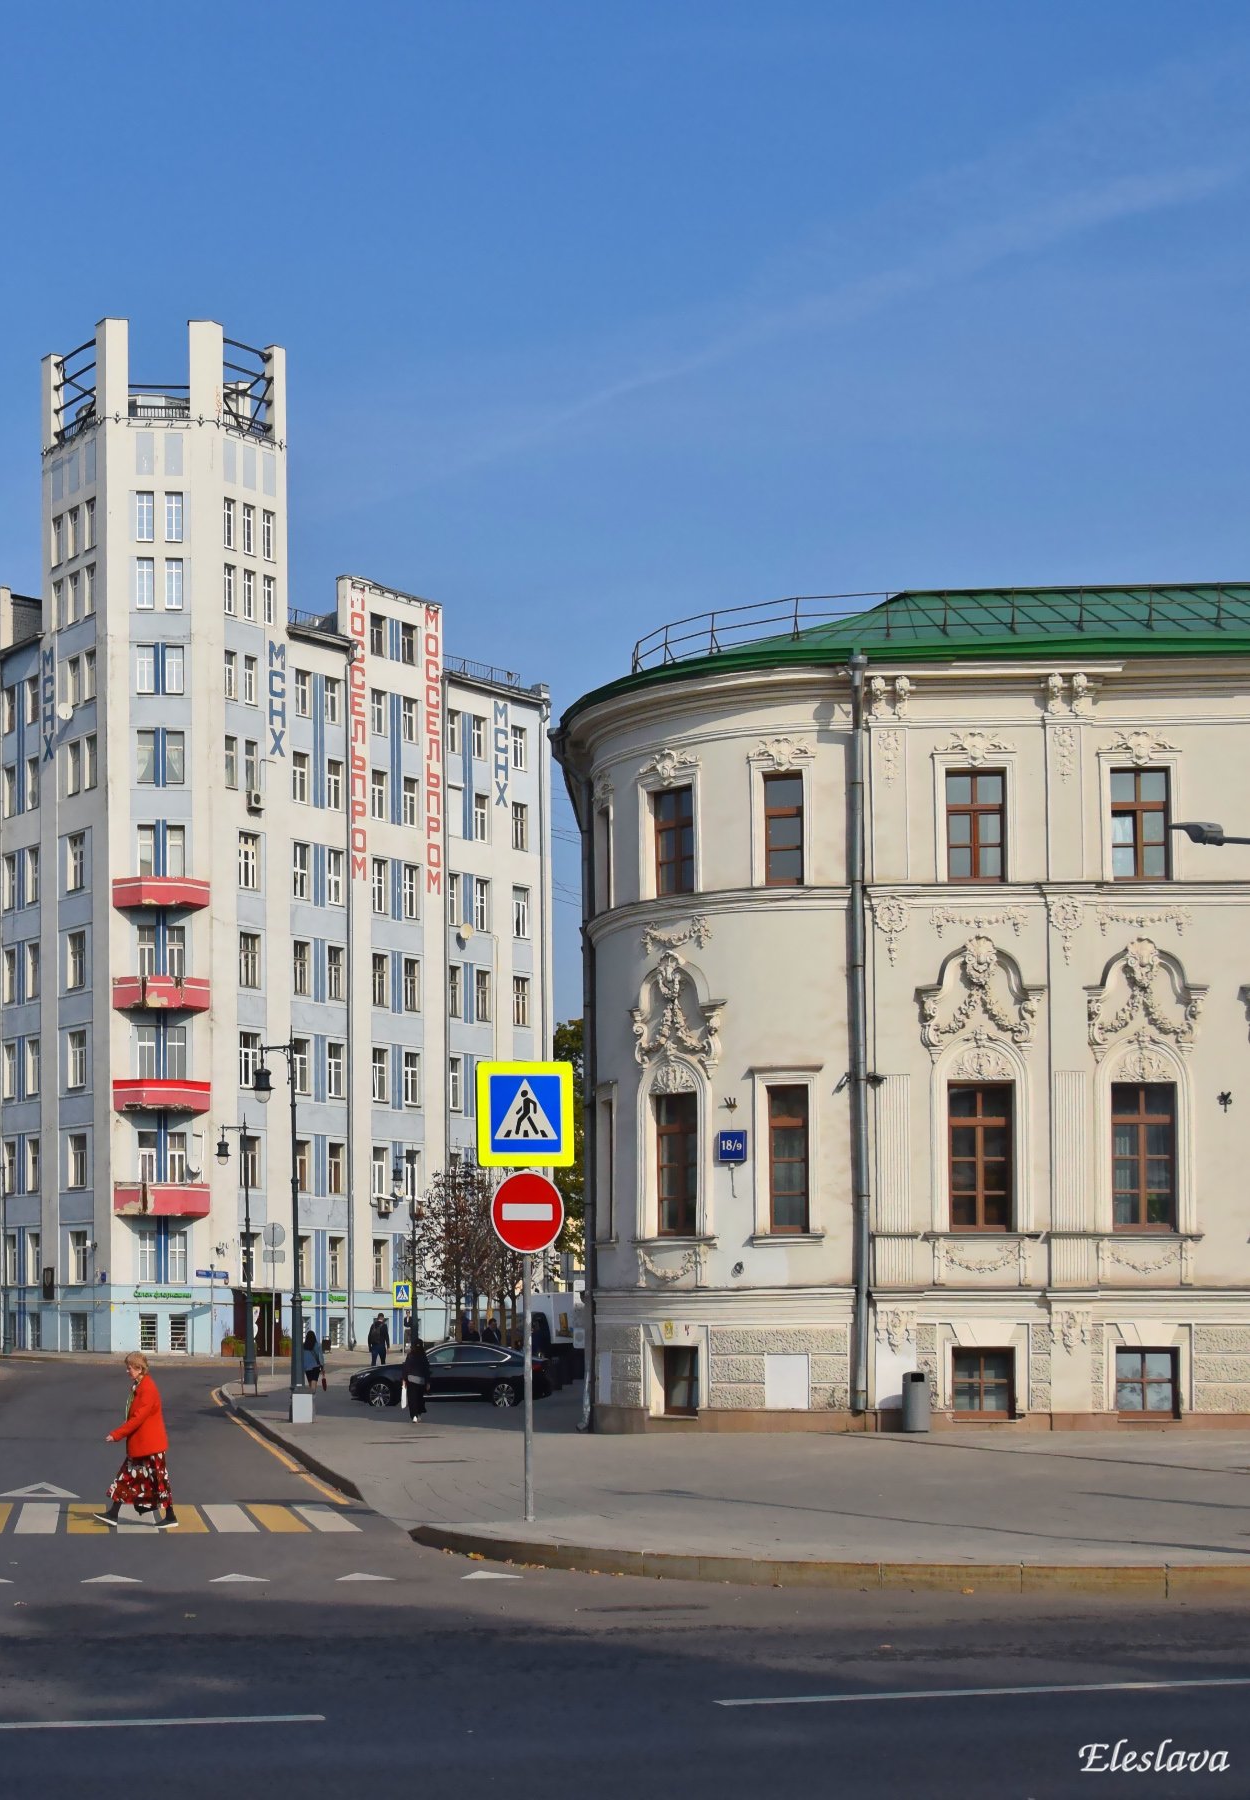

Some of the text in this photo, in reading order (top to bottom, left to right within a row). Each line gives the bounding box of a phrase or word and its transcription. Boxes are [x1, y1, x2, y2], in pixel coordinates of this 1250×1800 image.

[42, 646, 54, 763] МСНХ
[269, 639, 285, 757] МСНХ
[425, 605, 441, 894] МОССЕЛЬПРОМ
[493, 700, 508, 808] МСНХ
[721, 1139, 742, 1151] 18/9
